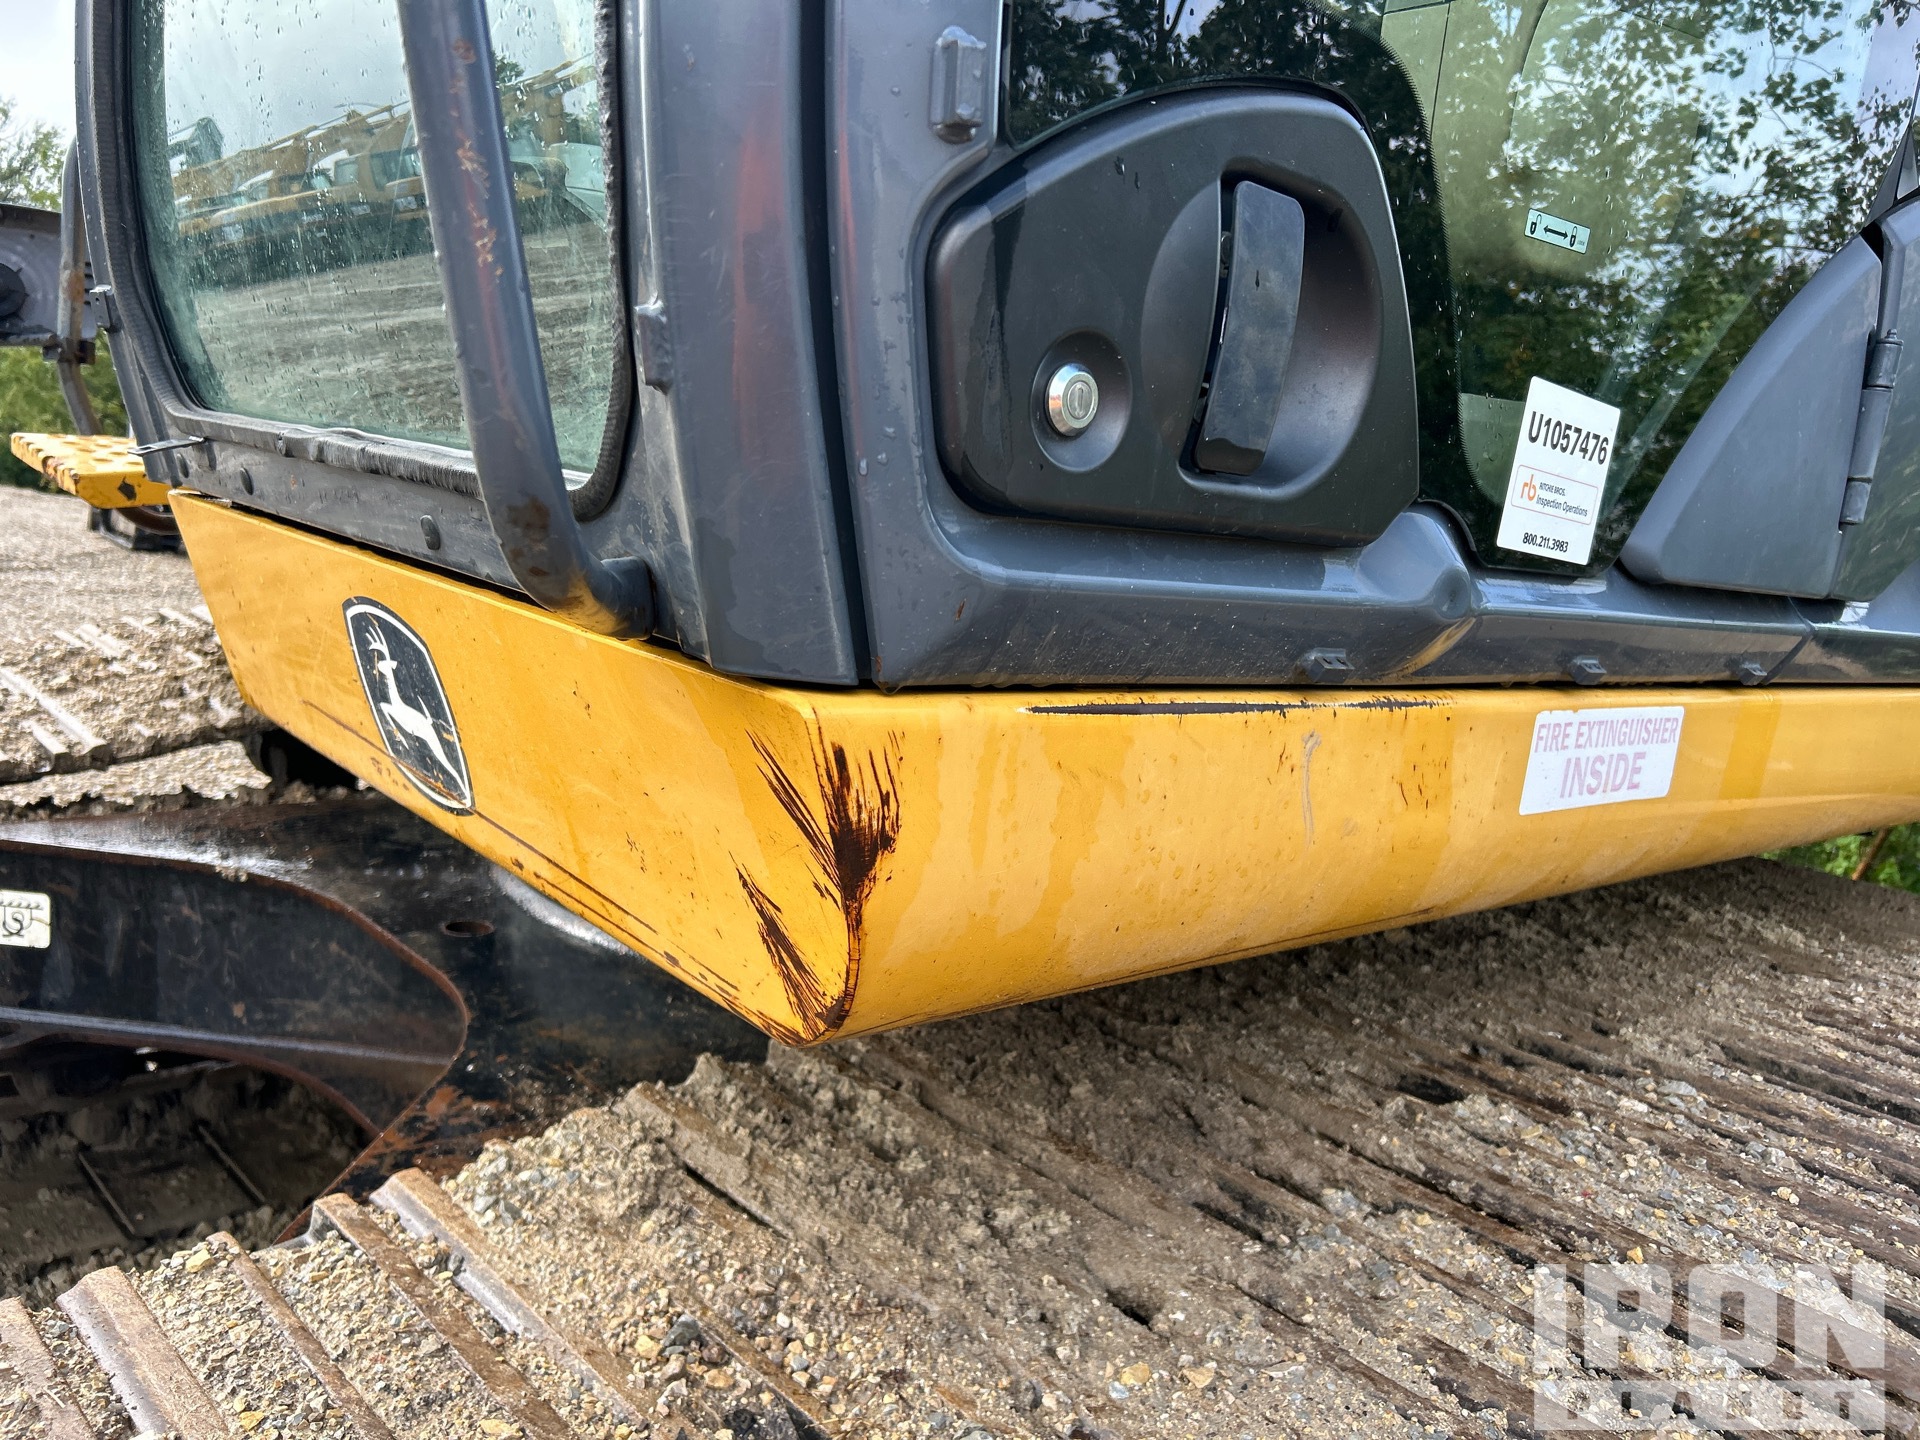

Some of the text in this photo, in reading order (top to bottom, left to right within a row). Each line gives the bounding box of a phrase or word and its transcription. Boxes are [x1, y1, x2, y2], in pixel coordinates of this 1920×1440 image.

[1528, 411, 1609, 466] U1057476
[1520, 474, 1537, 501] rb
[1539, 482, 1555, 494] RITCHIE
[1536, 494, 1588, 517] Inspection Operations
[1522, 532, 1569, 553] 800.211.3983
[1534, 717, 1679, 753] FIRE EXTINGUISHER
[1559, 751, 1647, 798] INSIDE
